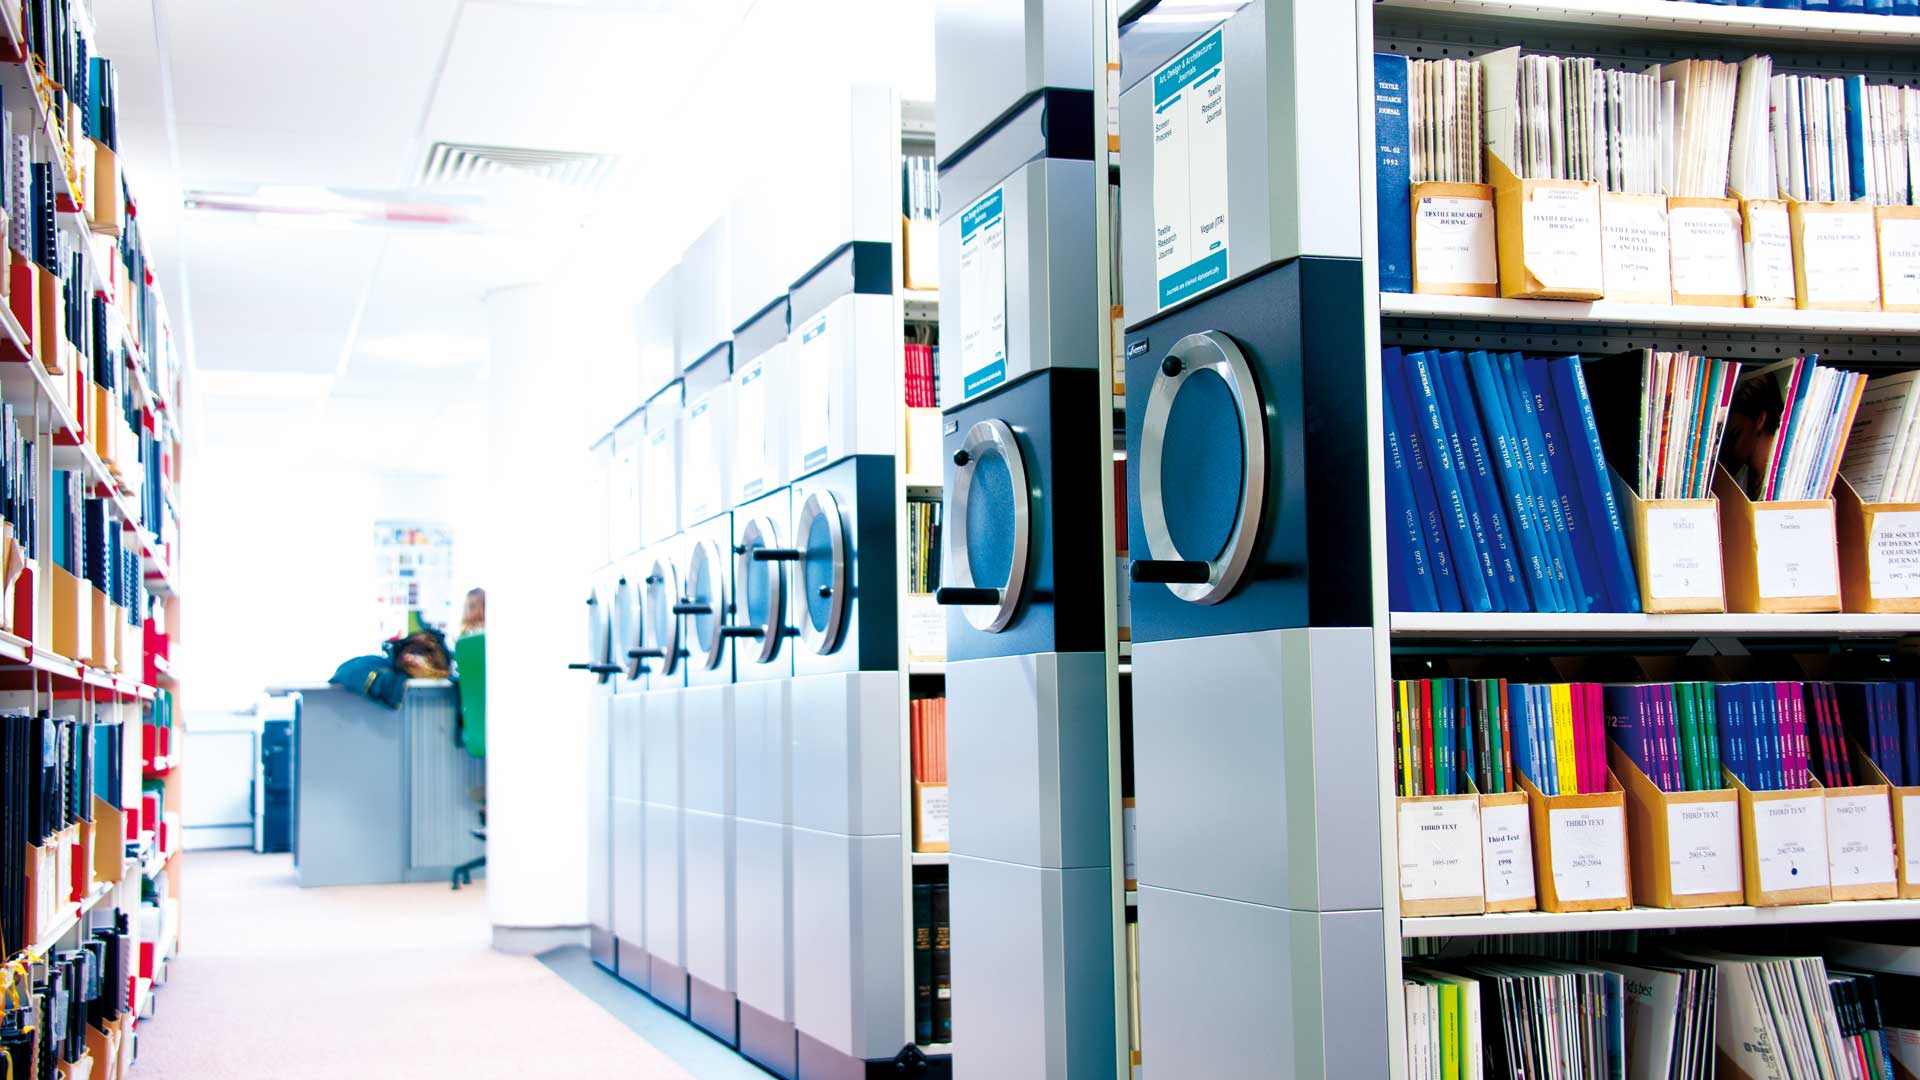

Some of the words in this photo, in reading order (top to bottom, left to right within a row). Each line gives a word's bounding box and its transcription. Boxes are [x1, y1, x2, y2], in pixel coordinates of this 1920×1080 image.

[1166, 64, 1181, 79] Design
[1182, 60, 1186, 69] &
[1178, 65, 1197, 84] Journals
[1208, 84, 1222, 98] Textile
[1378, 82, 1400, 90] TEXTILE
[1202, 96, 1222, 114] Research
[1376, 95, 1402, 104] RESEARCH
[1206, 107, 1222, 124] Journal
[1378, 108, 1401, 116] JOURNAL
[1155, 119, 1170, 133] Screen
[1156, 128, 1172, 143] Process
[1158, 225, 1172, 236] Textile
[1200, 221, 1214, 234] Vogue
[1158, 234, 1176, 247] Research
[1158, 245, 1174, 260] Journal
[1417, 360, 1431, 397] IMPERFECT
[1389, 432, 1401, 469] TEXTILES
[1410, 433, 1423, 470] TEXTILES
[1451, 433, 1466, 470] TEXTILES
[1470, 437, 1486, 476] TEXTILES
[1498, 435, 1512, 469] TEXTILES
[1522, 437, 1534, 471] TEXTILES
[1451, 489, 1466, 530] TEXTILES
[1551, 499, 1564, 532] TEXTILES
[1561, 495, 1575, 532] TEXTILES
[1605, 491, 1619, 531] TEXTILES
[1639, 982, 1652, 996] best
